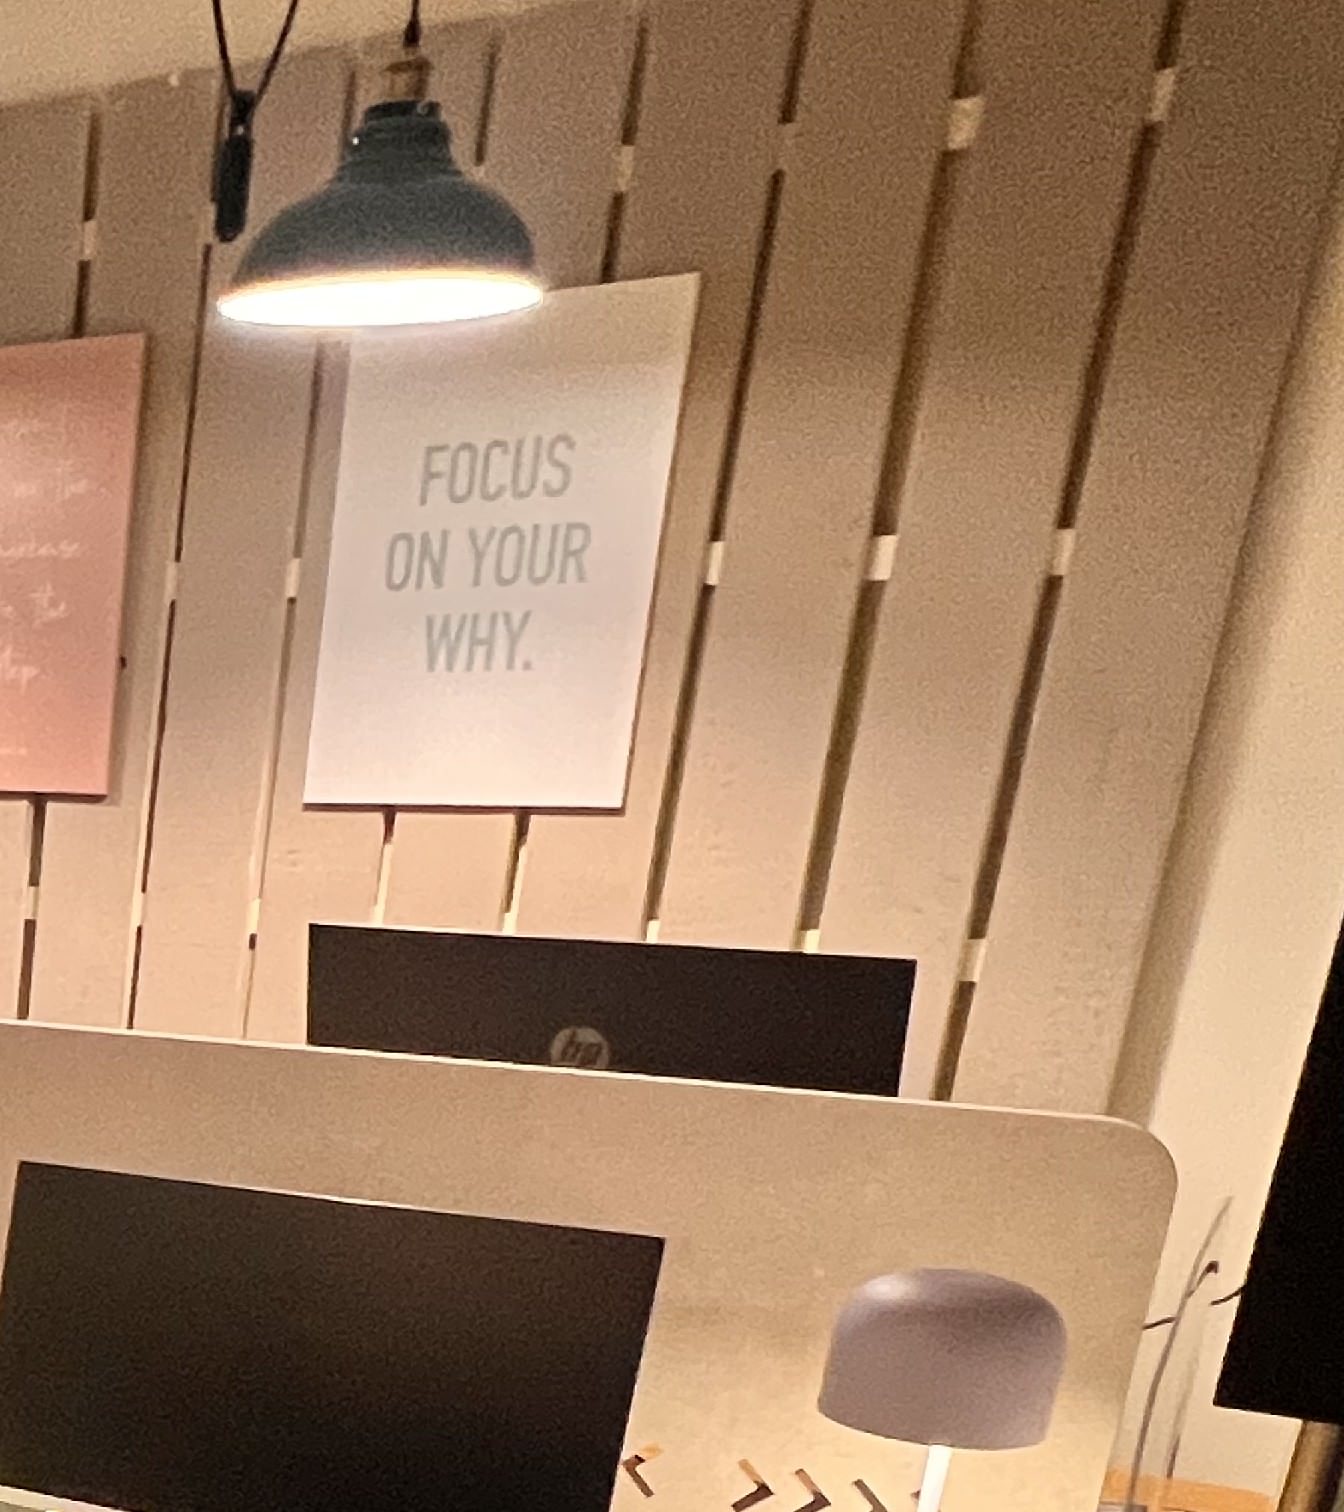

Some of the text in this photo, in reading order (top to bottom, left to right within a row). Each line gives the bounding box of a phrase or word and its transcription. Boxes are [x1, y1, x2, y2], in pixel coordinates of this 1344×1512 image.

[419, 433, 577, 507] FOCUS
[385, 521, 592, 592] ON YOUR
[425, 609, 535, 674] WHY.
